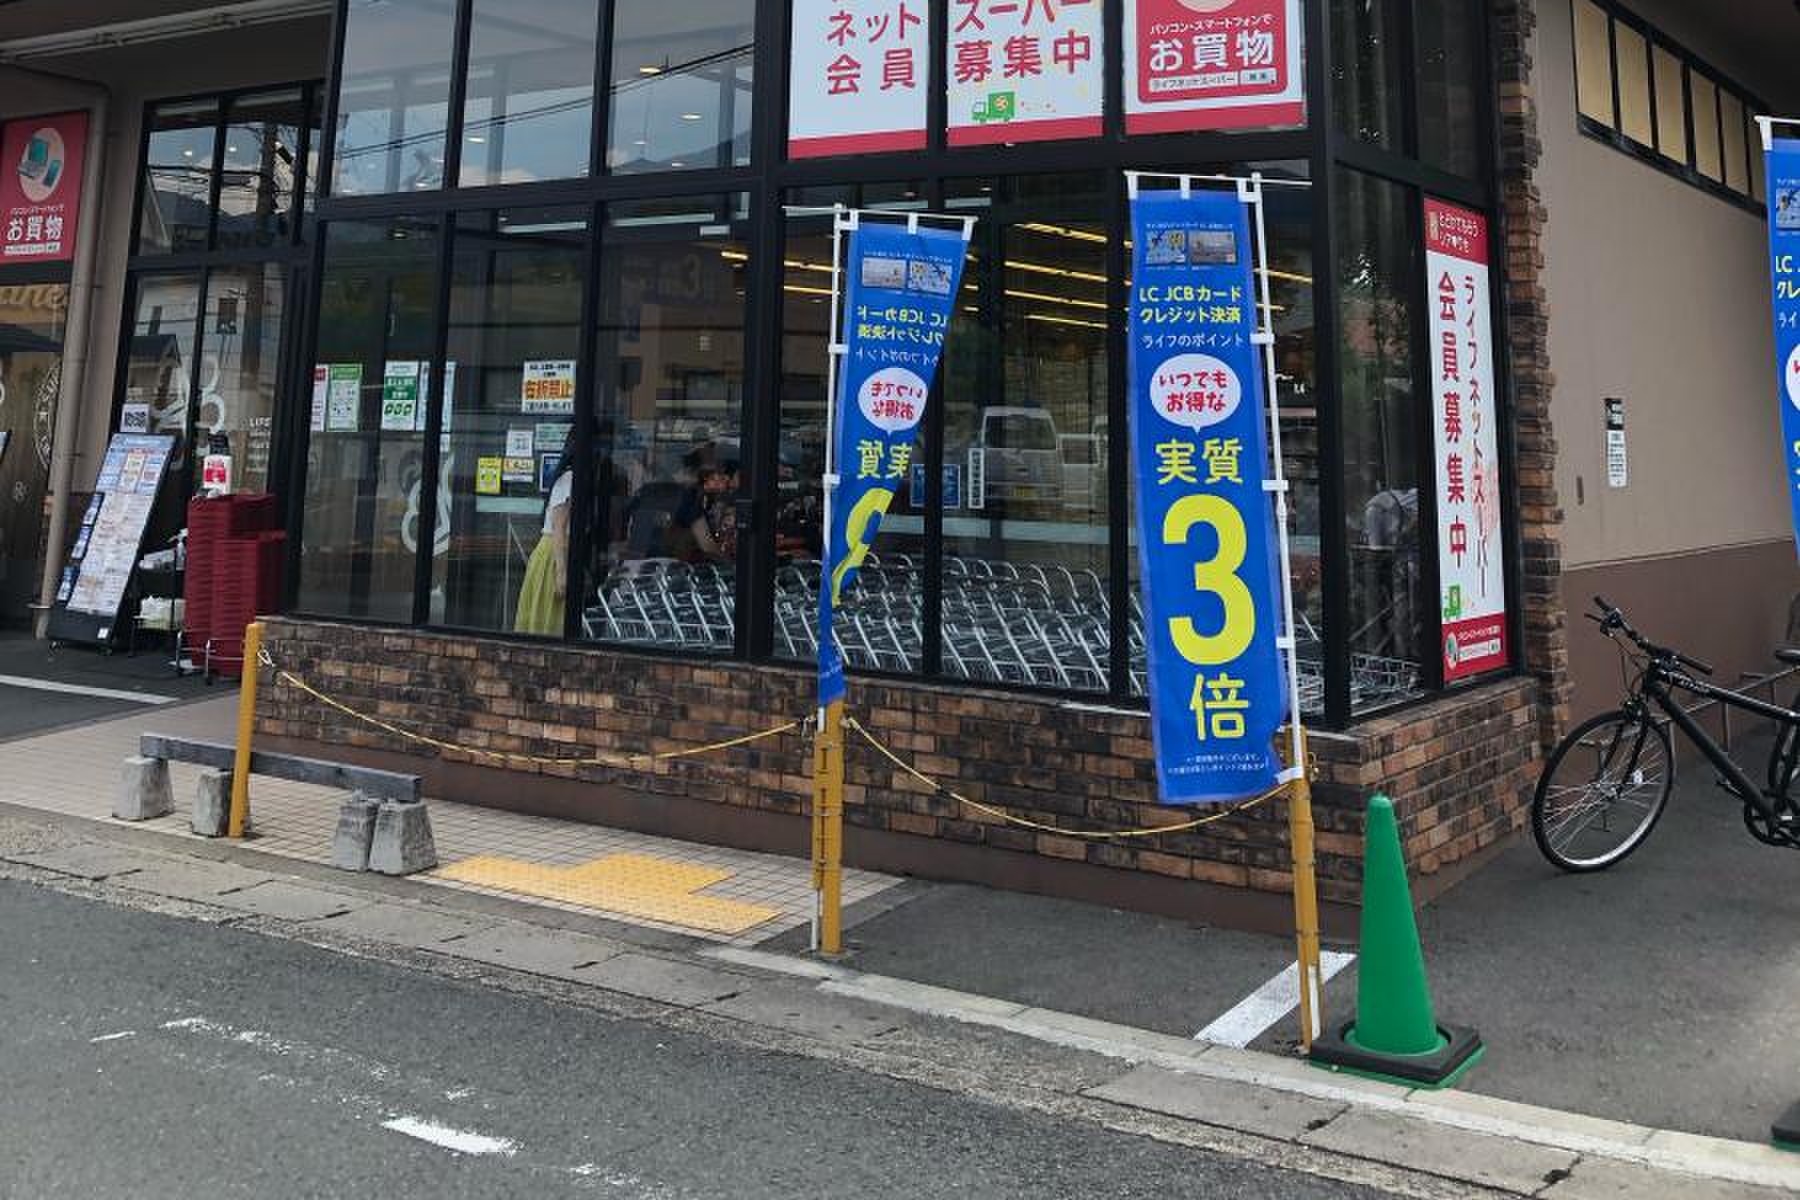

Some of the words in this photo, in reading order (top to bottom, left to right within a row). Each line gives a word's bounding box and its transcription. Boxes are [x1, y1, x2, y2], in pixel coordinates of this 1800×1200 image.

[827, 2, 921, 46] ネット
[827, 47, 917, 96] 会員
[953, 30, 1092, 84] 募集中
[1150, 30, 1275, 72] お買物
[6, 215, 64, 241] お買物
[1140, 287, 1160, 302] LC
[1164, 285, 1243, 302] JCBカード
[1139, 306, 1242, 325] クレジット決済
[1141, 332, 1244, 350] ライフのポイント
[1158, 370, 1228, 389] いつでも
[1166, 391, 1227, 413] お得な
[1439, 271, 1467, 569] 会員募集中
[1155, 437, 1244, 485] 実質
[1162, 493, 1256, 666] 3
[1189, 672, 1249, 742] 倍
